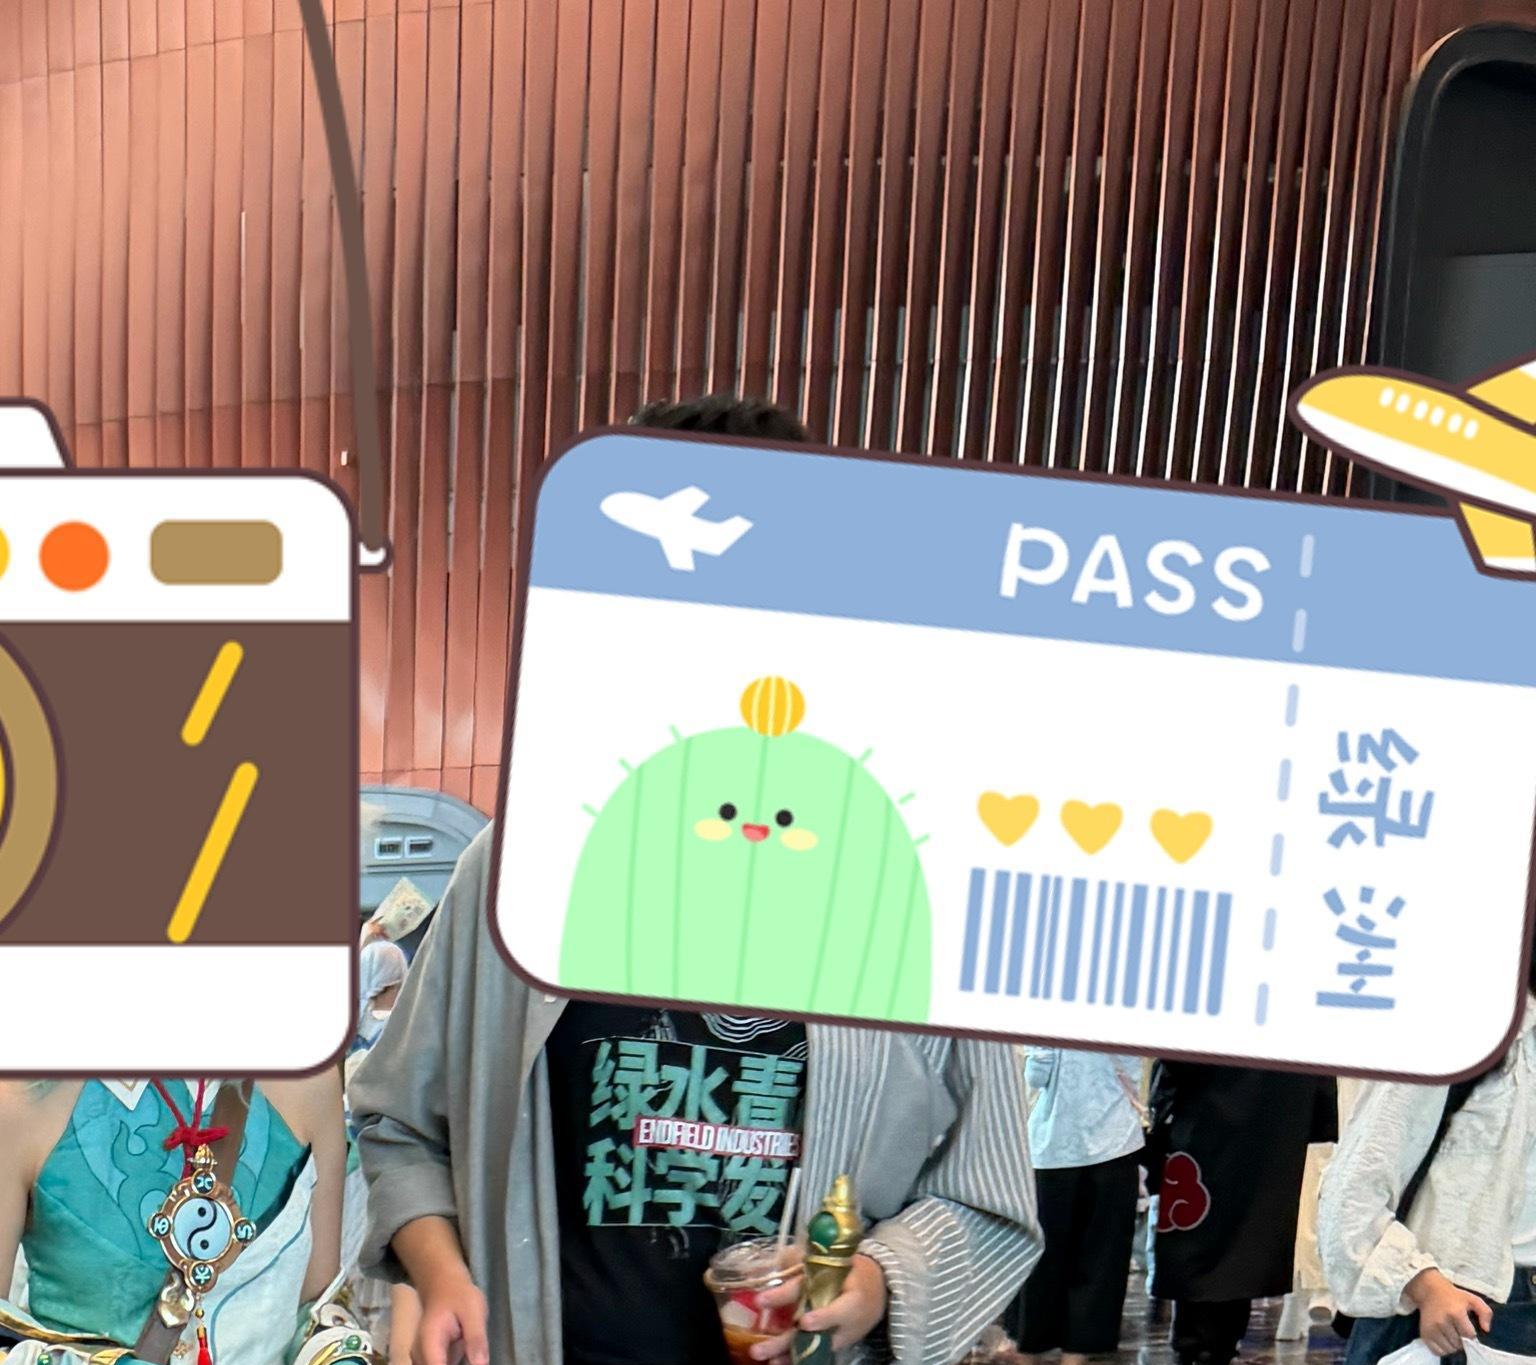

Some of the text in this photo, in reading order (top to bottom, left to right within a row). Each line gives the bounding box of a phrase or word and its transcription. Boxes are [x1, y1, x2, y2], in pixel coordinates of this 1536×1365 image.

[638, 1118, 715, 1151] ENDFIELD
[582, 1138, 788, 1236] 科学发
